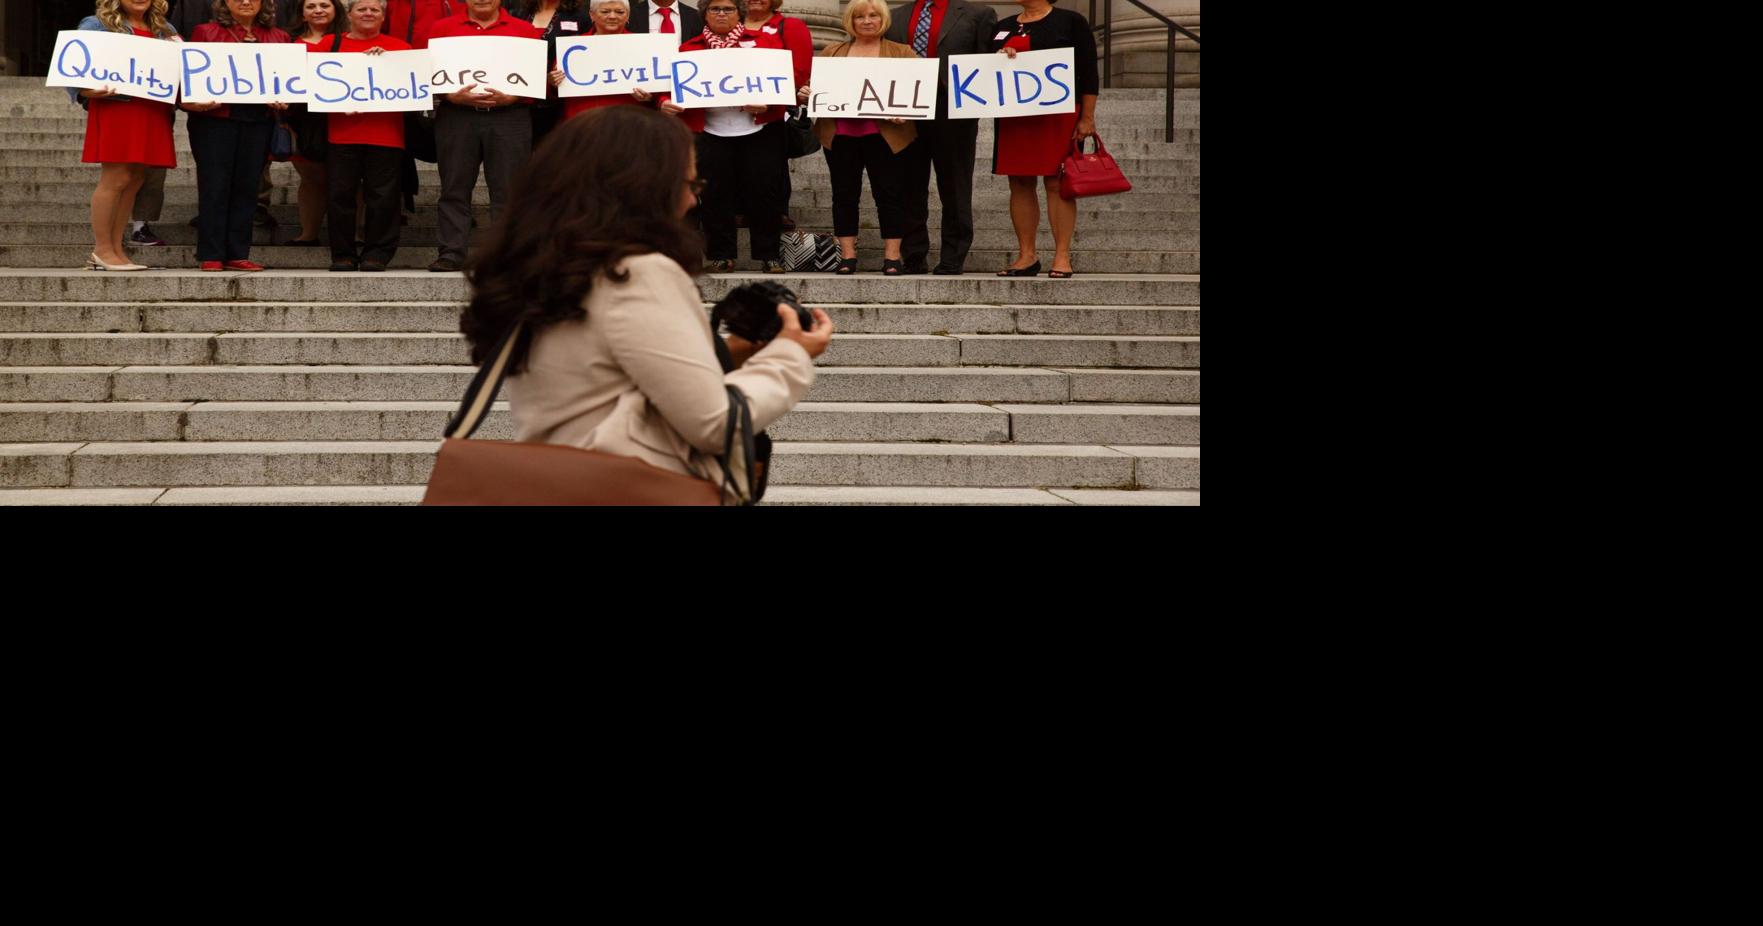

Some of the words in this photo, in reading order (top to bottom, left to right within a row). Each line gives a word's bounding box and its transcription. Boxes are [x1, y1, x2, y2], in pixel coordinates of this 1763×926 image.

[57, 39, 173, 97] Quality
[181, 48, 307, 95] Public
[314, 60, 429, 103] Schools
[432, 69, 489, 86] are
[507, 72, 528, 87] a
[562, 45, 671, 86] CIVIL
[671, 60, 788, 104] RIGHT
[952, 63, 1070, 108] KIDS
[857, 79, 930, 111] ALL
